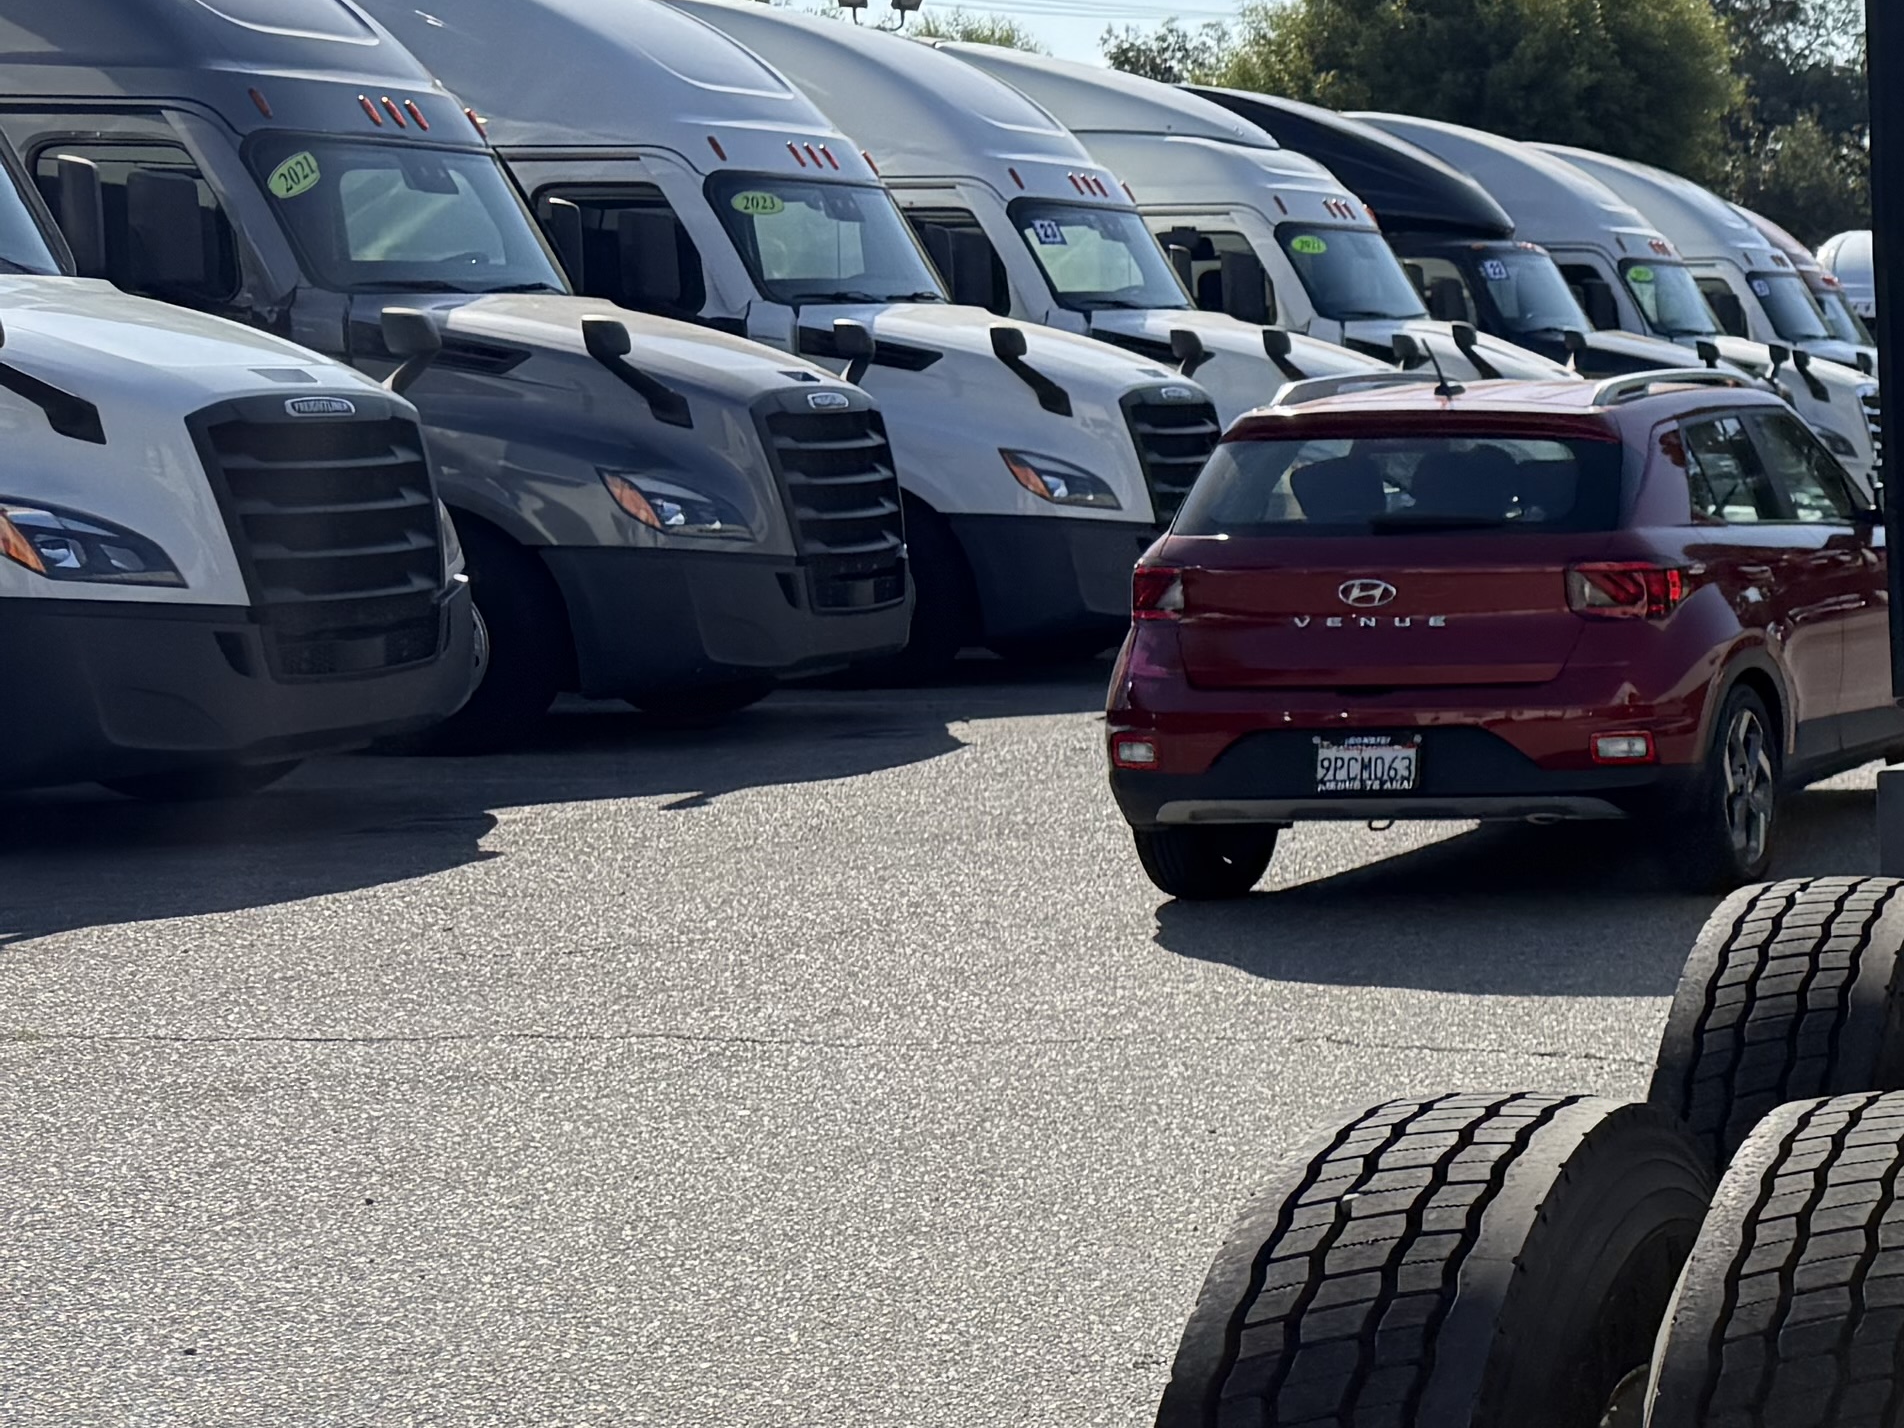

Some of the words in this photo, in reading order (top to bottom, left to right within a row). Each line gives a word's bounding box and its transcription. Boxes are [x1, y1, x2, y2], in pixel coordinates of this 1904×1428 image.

[278, 155, 316, 193] 2021
[742, 195, 776, 210] 2023
[1293, 615, 1447, 628] VENUE
[1320, 755, 1413, 781] 9PCM063
